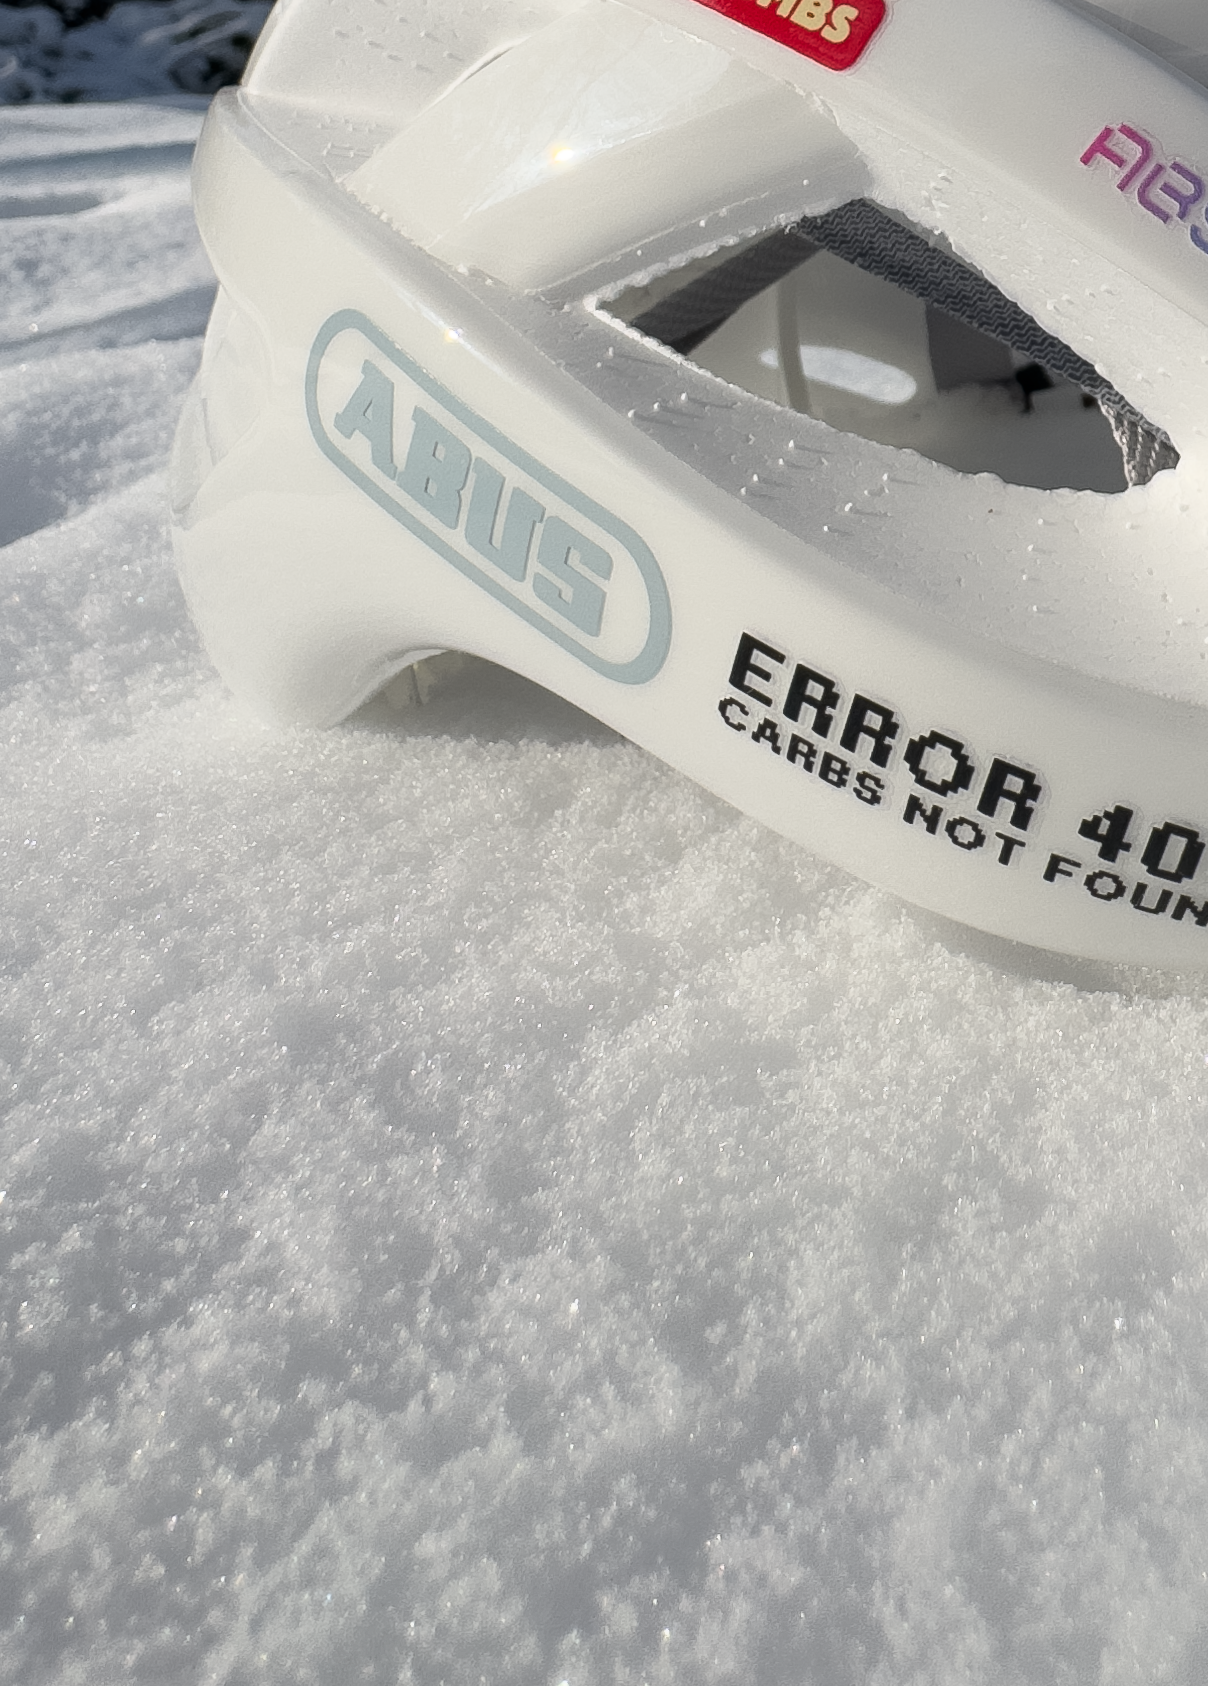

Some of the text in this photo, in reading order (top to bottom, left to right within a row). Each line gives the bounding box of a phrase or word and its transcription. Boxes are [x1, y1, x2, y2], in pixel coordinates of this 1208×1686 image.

[333, 359, 614, 637] ABUS
[718, 696, 885, 806] CARBS
[902, 794, 1026, 866] NOT
[728, 631, 1042, 831] ERROR
